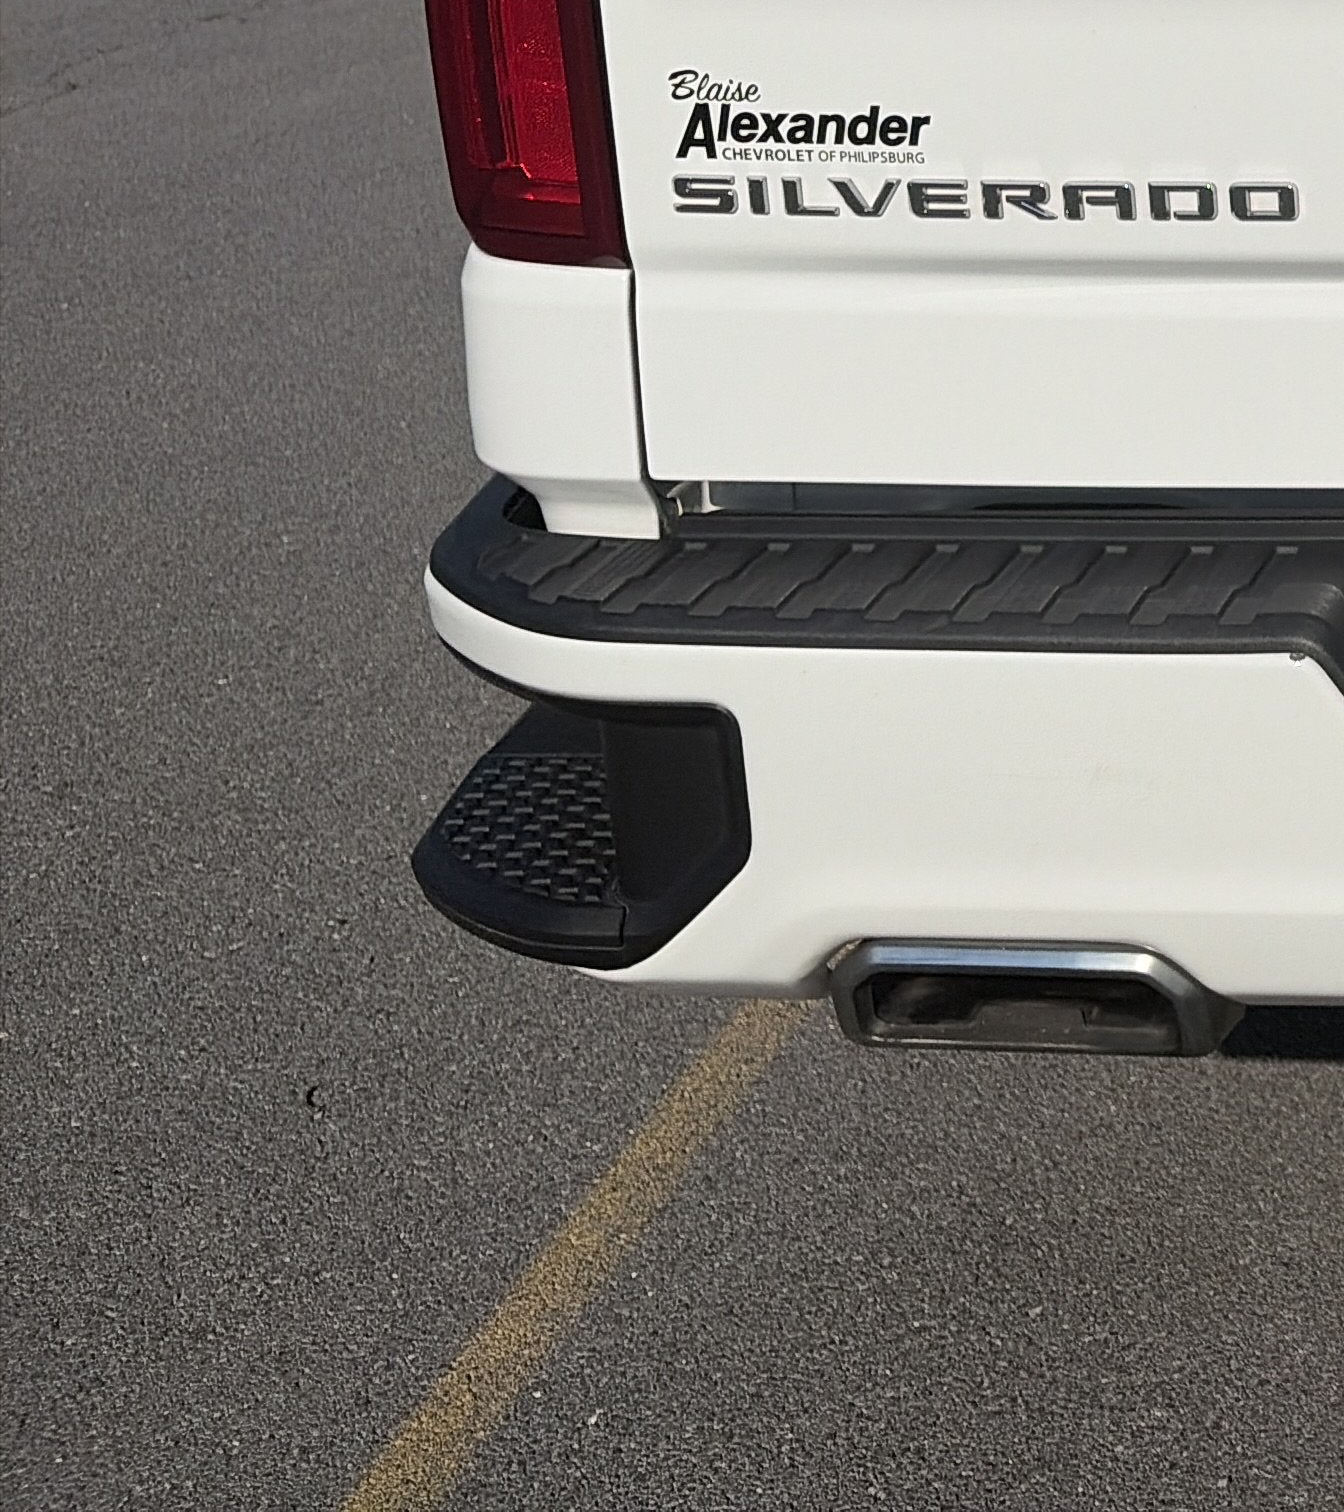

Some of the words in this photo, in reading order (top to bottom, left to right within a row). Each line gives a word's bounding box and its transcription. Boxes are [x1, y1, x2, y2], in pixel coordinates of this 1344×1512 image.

[668, 69, 761, 102] Blaise
[675, 102, 932, 160] Alexander
[721, 147, 815, 162] CHEVROLET
[818, 149, 837, 162] OF
[839, 150, 926, 164] PHILIPSBURG
[672, 175, 1300, 222] SILVERADO
